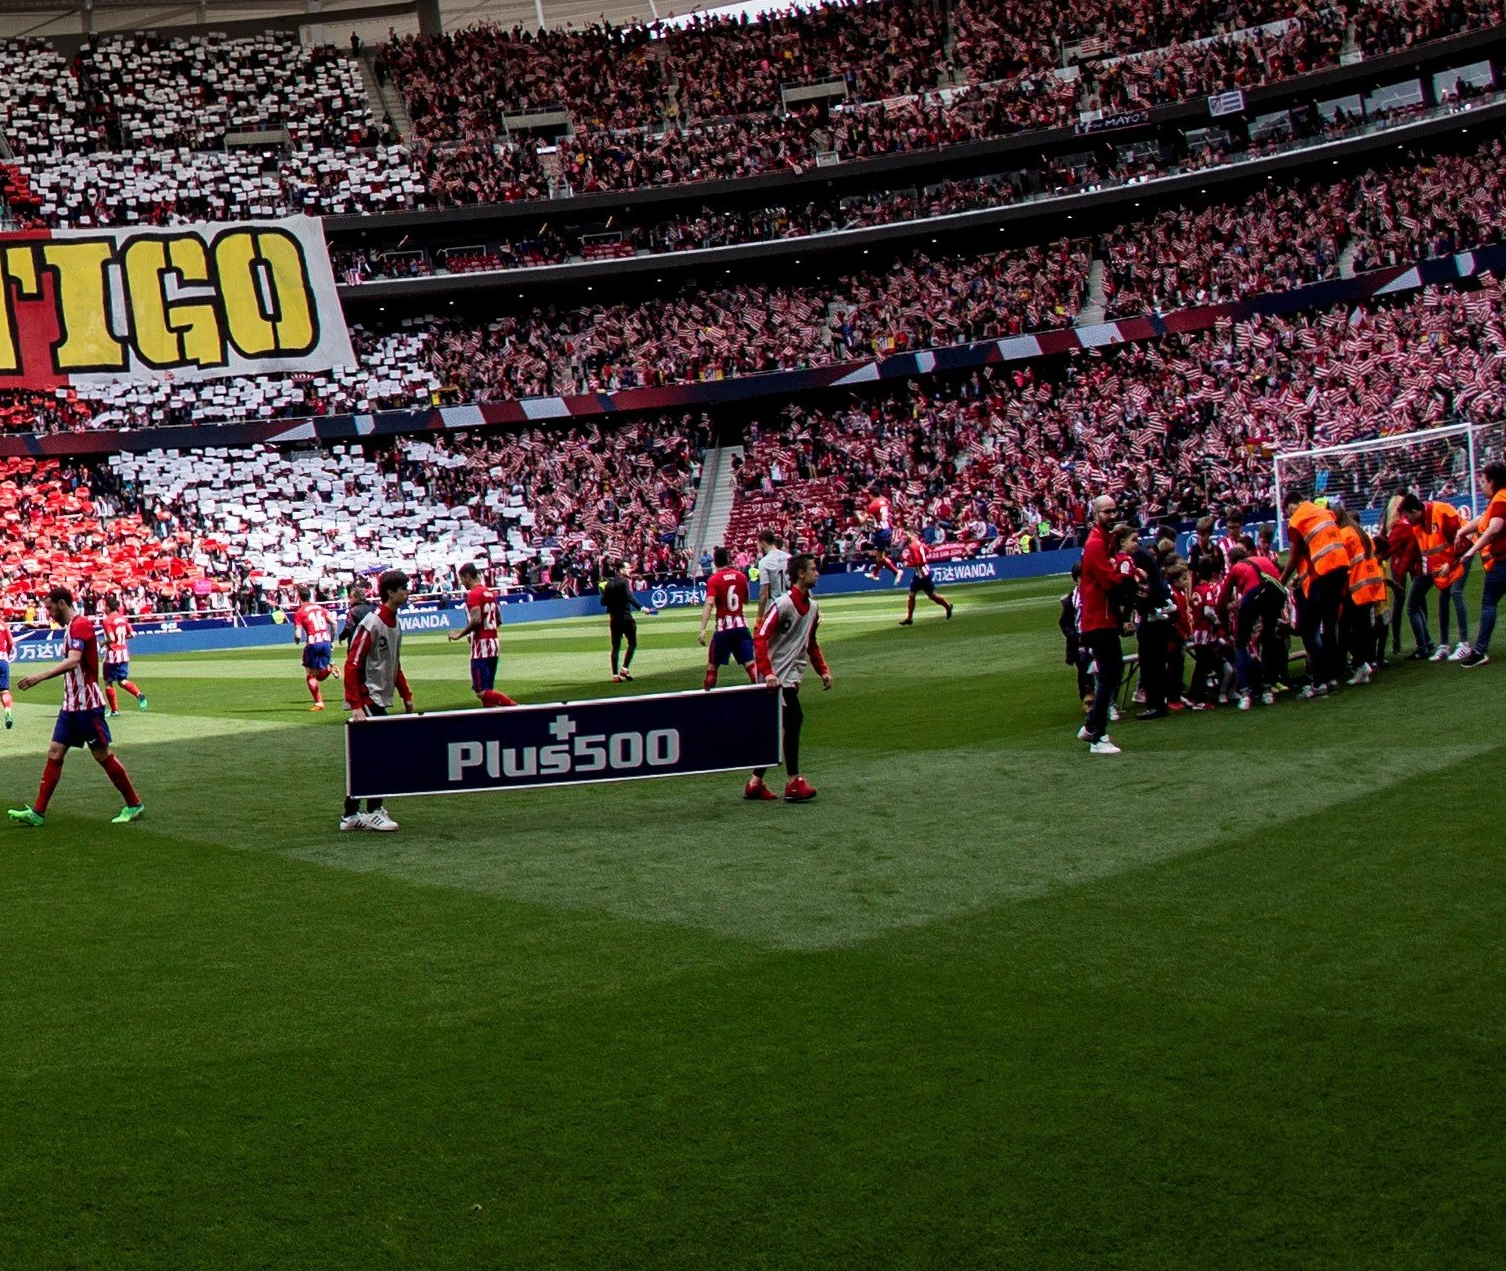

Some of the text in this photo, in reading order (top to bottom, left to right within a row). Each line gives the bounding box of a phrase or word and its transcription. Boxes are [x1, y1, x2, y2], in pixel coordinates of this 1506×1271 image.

[726, 585, 739, 612] 6
[308, 610, 327, 631] 16
[447, 728, 680, 782] Plus500
